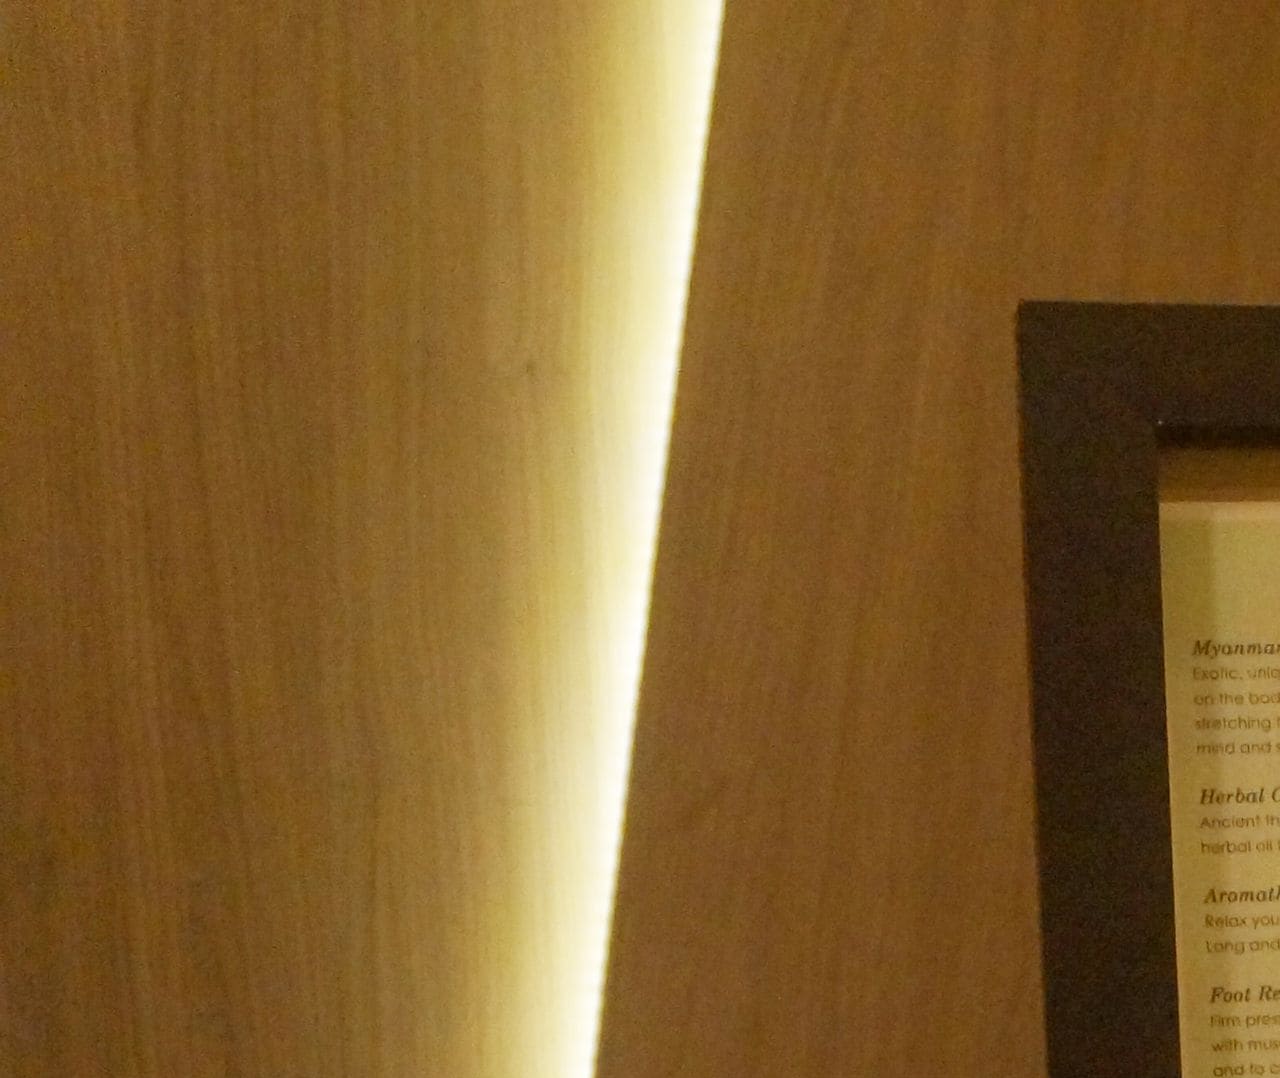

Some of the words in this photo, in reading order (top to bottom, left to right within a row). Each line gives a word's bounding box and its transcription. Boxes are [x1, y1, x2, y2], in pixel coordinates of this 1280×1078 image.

[1200, 787, 1265, 805] Herbal
[1204, 914, 1246, 928] Relax
[1205, 940, 1245, 955] Long
[1250, 938, 1280, 951] and
[1209, 986, 1250, 1003] Foot
